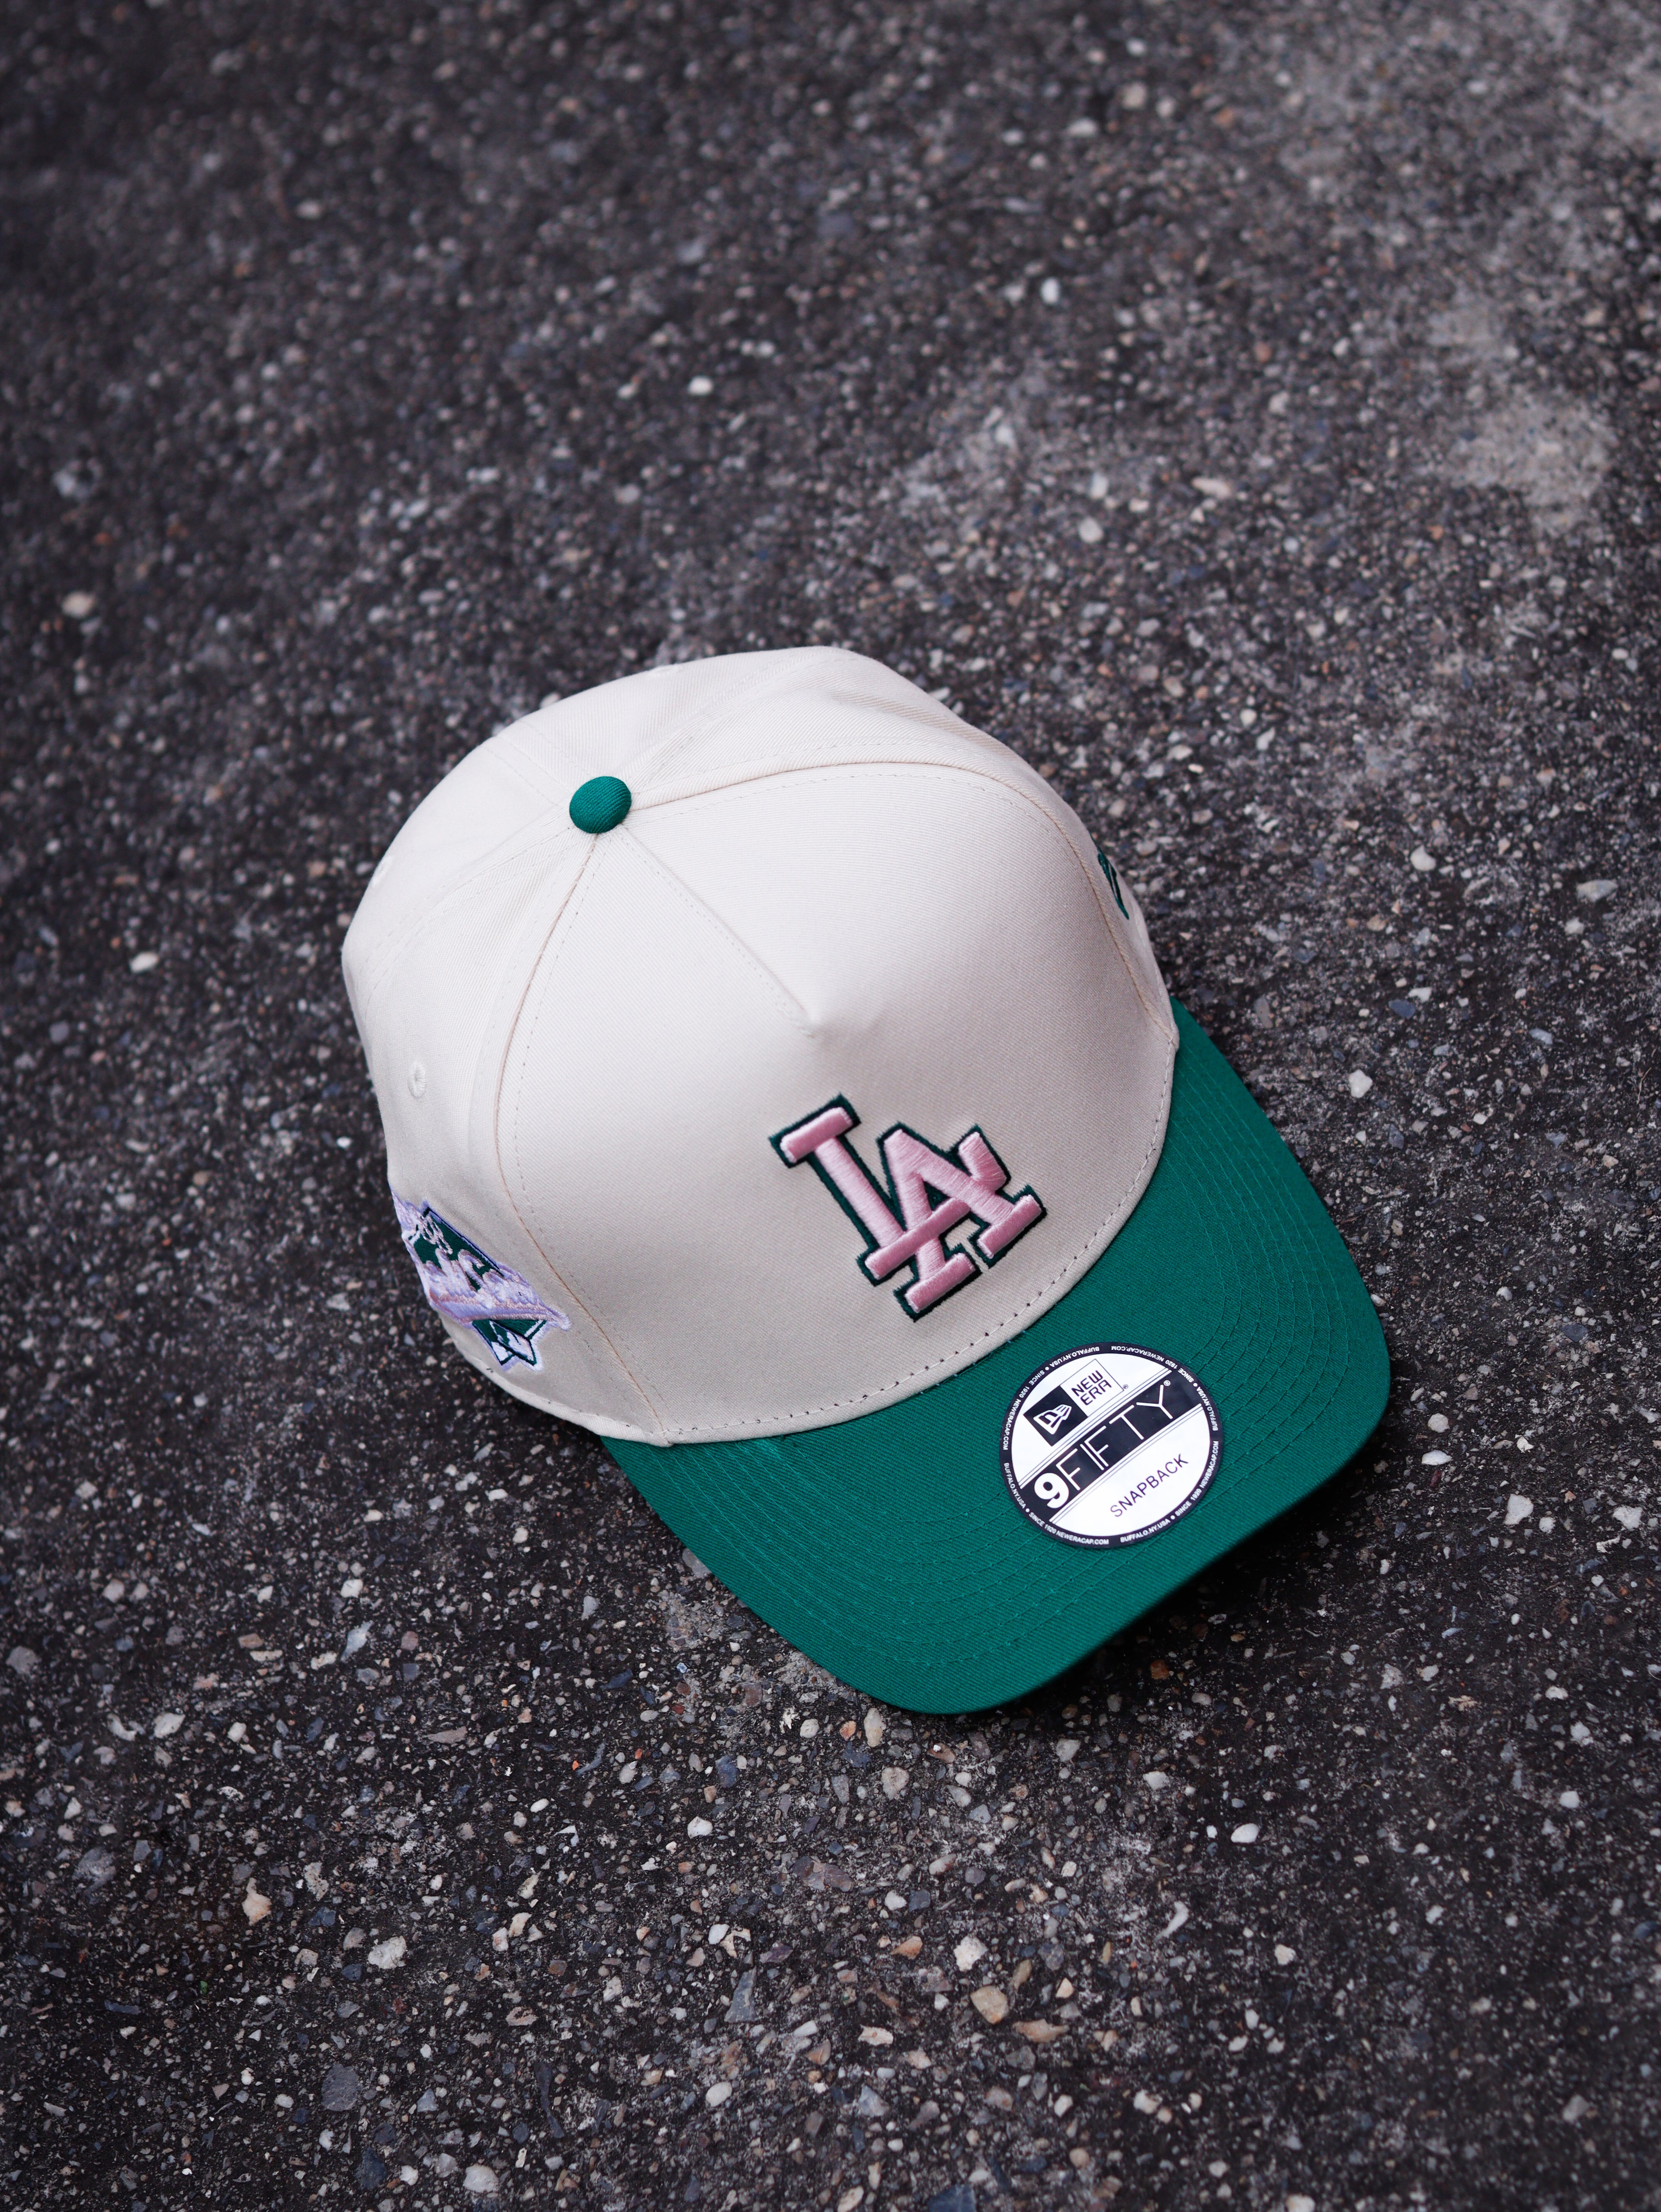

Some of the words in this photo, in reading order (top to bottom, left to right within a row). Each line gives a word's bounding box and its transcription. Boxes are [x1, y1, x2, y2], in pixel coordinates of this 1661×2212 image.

[769, 1092, 1047, 1322] LA
[1111, 1345, 1164, 1362] NEWERACAP.COM
[1165, 1359, 1178, 1369] 1920
[1028, 1370, 1045, 1386] SINCE
[1071, 1370, 1103, 1397] NEW
[1178, 1367, 1194, 1383] SINCE
[1019, 1386, 1030, 1398] 1920
[1080, 1379, 1112, 1405] ERA
[1003, 1398, 1022, 1450] NEWERACAP.COM
[1110, 1453, 1189, 1517] SNAPBACK
[1174, 1501, 1192, 1517] SINCE
[1199, 1441, 1219, 1489] NEWERACAP.COM
[1029, 1512, 1045, 1527] SINCE
[1044, 1524, 1057, 1534] 1920
[1056, 1530, 1109, 1545] NEWERACAP.COM
